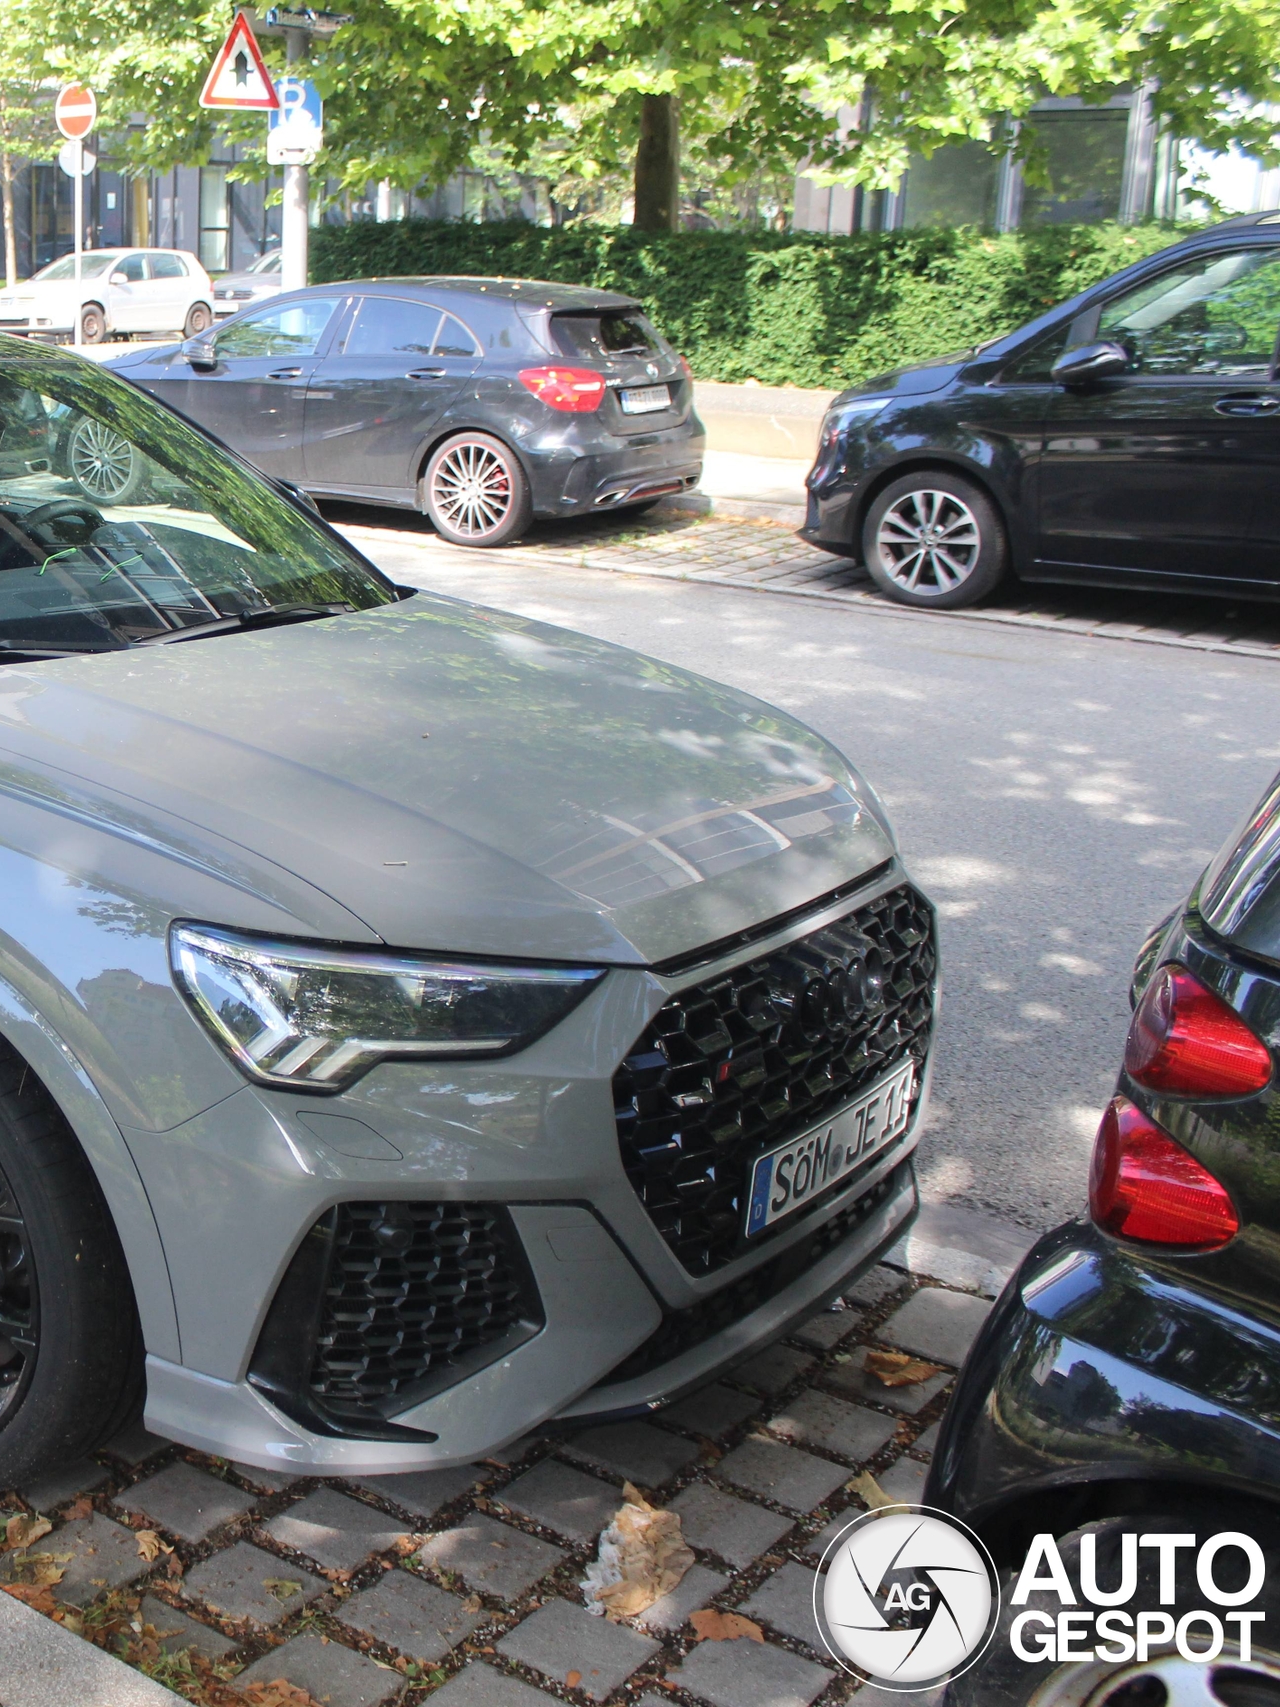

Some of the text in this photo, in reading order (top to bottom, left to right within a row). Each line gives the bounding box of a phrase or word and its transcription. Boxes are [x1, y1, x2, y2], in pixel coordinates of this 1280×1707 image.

[277, 83, 308, 126] P
[771, 1126, 833, 1213] SÖM
[845, 1095, 880, 1165] JE
[754, 1203, 763, 1220] D
